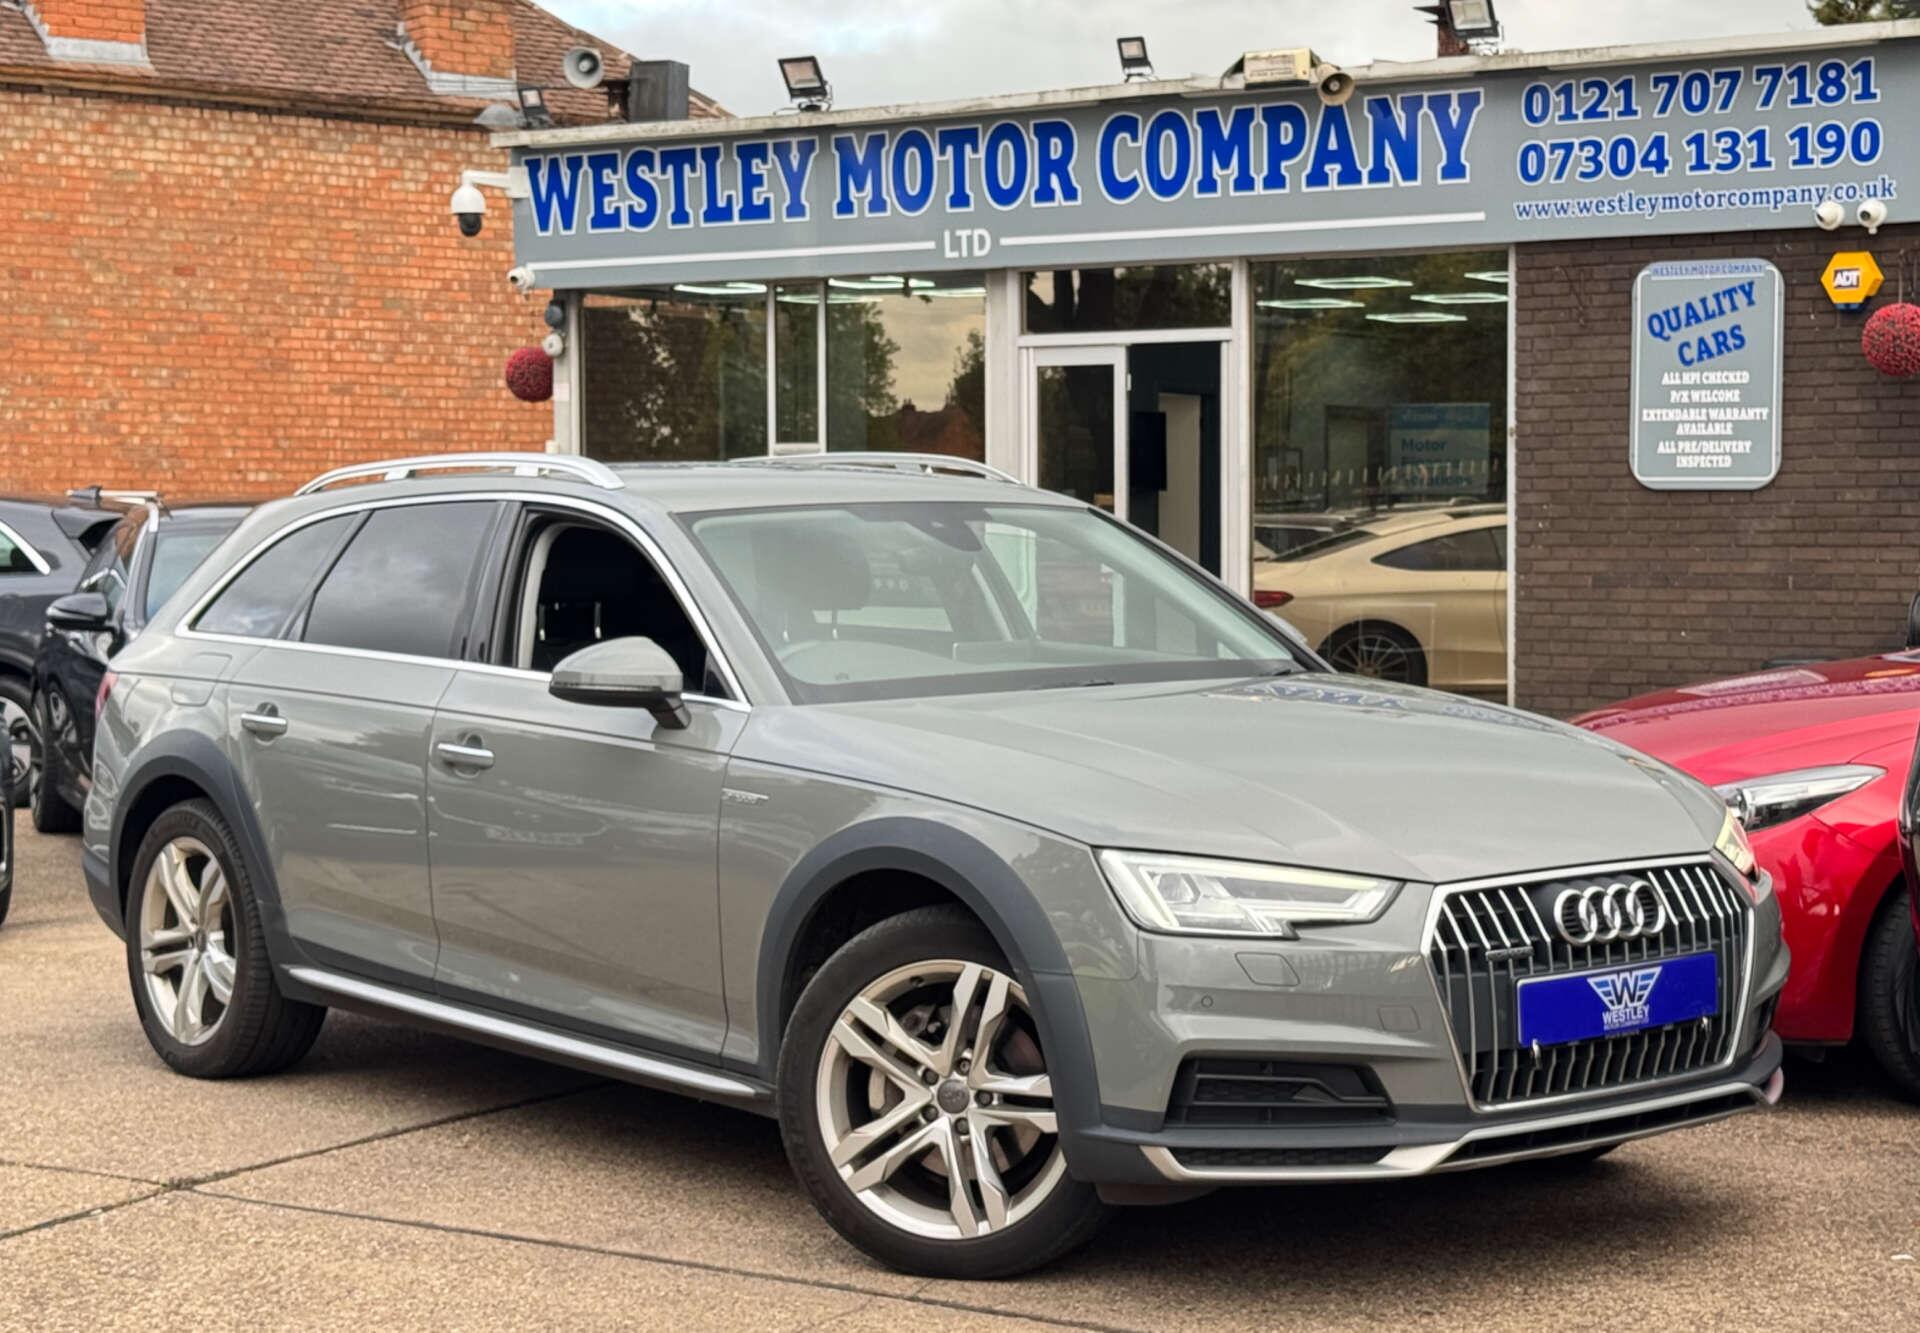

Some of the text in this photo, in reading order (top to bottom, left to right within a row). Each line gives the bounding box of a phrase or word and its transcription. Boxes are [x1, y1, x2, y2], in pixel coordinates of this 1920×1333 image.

[1522, 57, 1880, 126] 0121 707 7181
[1517, 118, 1883, 184] 07304 131 190
[525, 87, 1484, 236] WESTLEY MOTOR COMPANY
[1515, 175, 1897, 220] www.westleymotorcompany.co.uk
[943, 228, 992, 259] LTD
[1833, 269, 1860, 288] ADT
[1647, 280, 1757, 342] QUALITY
[1678, 324, 1746, 367] CARS
[1661, 370, 1750, 385] ALL HPI CHECKED
[1670, 388, 1741, 403] P/X WELCOME
[1642, 406, 1769, 421] EXTENDABLE WARRANTY
[1675, 422, 1734, 435] AVAILABLE
[1401, 438, 1447, 452] Motor
[1657, 439, 1752, 454] ALL PRE/DELIVERY
[1675, 455, 1732, 468] INSPECTED
[1602, 1004, 1650, 1026] WESTLEY
